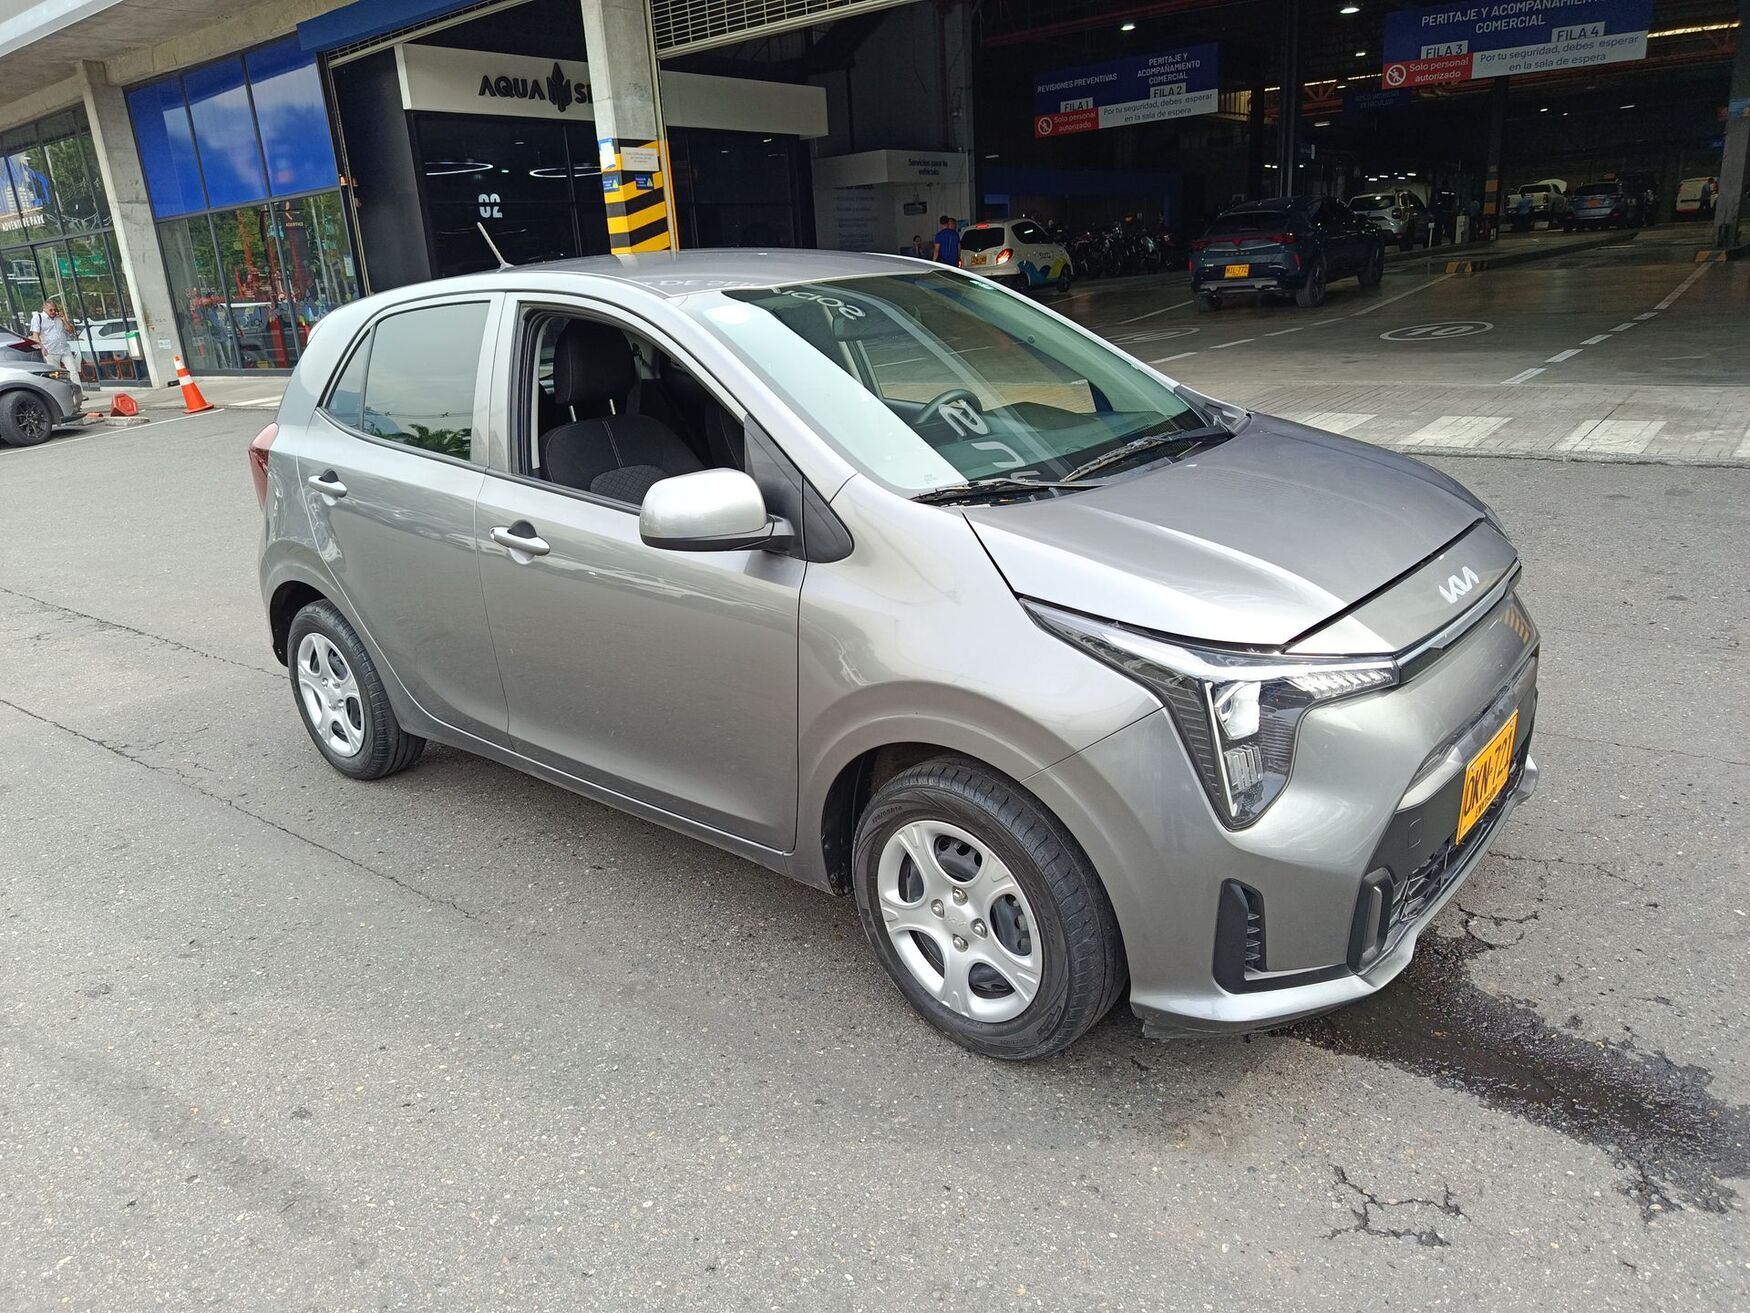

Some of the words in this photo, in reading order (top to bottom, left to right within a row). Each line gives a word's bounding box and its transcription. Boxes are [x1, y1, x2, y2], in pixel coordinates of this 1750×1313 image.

[1421, 9, 1478, 27] PERITAJE
[1481, 7, 1489, 18] Y
[1475, 14, 1547, 33] COMERCIAL
[1557, 28, 1587, 42] FILA
[1590, 25, 1599, 37] 4
[1426, 45, 1452, 58] FILA
[1455, 44, 1463, 55] 3
[1480, 54, 1496, 63] Por
[1498, 53, 1507, 61] tu
[1509, 45, 1560, 62] seguridad,
[1562, 40, 1594, 52] debes
[1599, 35, 1640, 49] esperar
[1149, 54, 1182, 66] PERITAJE
[1183, 52, 1188, 60] Y
[1409, 63, 1429, 73] Solo
[1430, 57, 1469, 71] personal
[1509, 63, 1522, 72] en
[1523, 61, 1532, 70] la
[1534, 59, 1554, 69] sala
[1556, 56, 1569, 66] de
[1571, 53, 1606, 67] espera
[1137, 60, 1200, 77] ACOMPAÑAMIENTO
[1415, 70, 1461, 82] autorizado
[1037, 80, 1073, 93] REVISIONES
[1074, 73, 1118, 87] PREVENTIVAS
[1149, 71, 1188, 85] COMERCIAL
[478, 75, 546, 100] AQUA
[1153, 87, 1175, 98] FILA
[1176, 86, 1183, 95] 2
[1064, 101, 1084, 112] FILA
[1103, 108, 1114, 116] Por
[1185, 93, 1213, 105] esperar
[1069, 111, 1096, 122] personal
[1059, 121, 1092, 132] autorizado
[478, 193, 503, 218] 02
